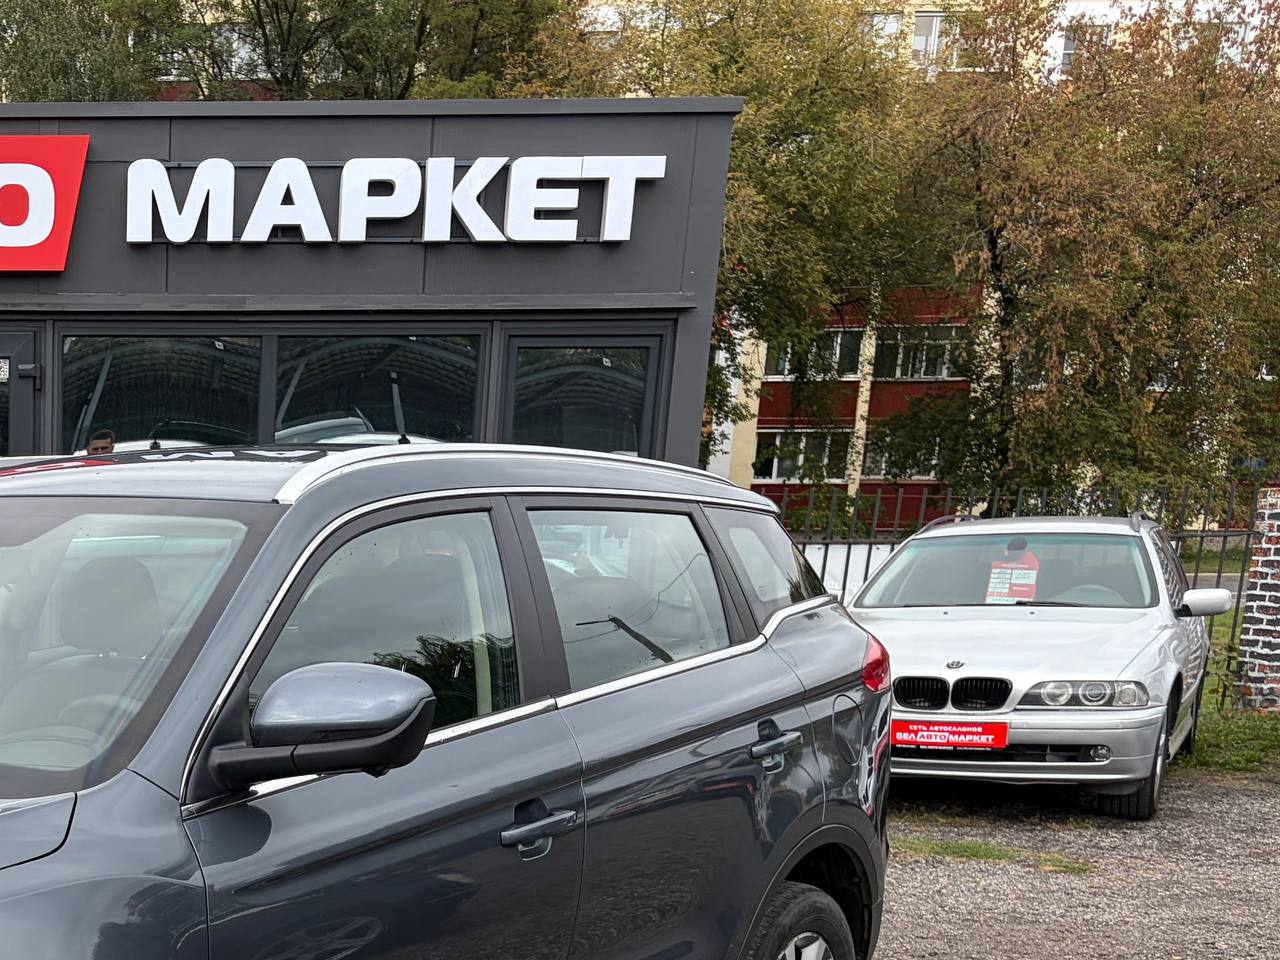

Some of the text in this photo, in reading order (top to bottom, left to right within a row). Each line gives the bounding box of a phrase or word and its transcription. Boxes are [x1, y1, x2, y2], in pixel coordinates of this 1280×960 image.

[126, 155, 667, 246] МАРКЕТ
[918, 732, 947, 741] АВТО
[949, 734, 994, 744] МАРКЕТ
